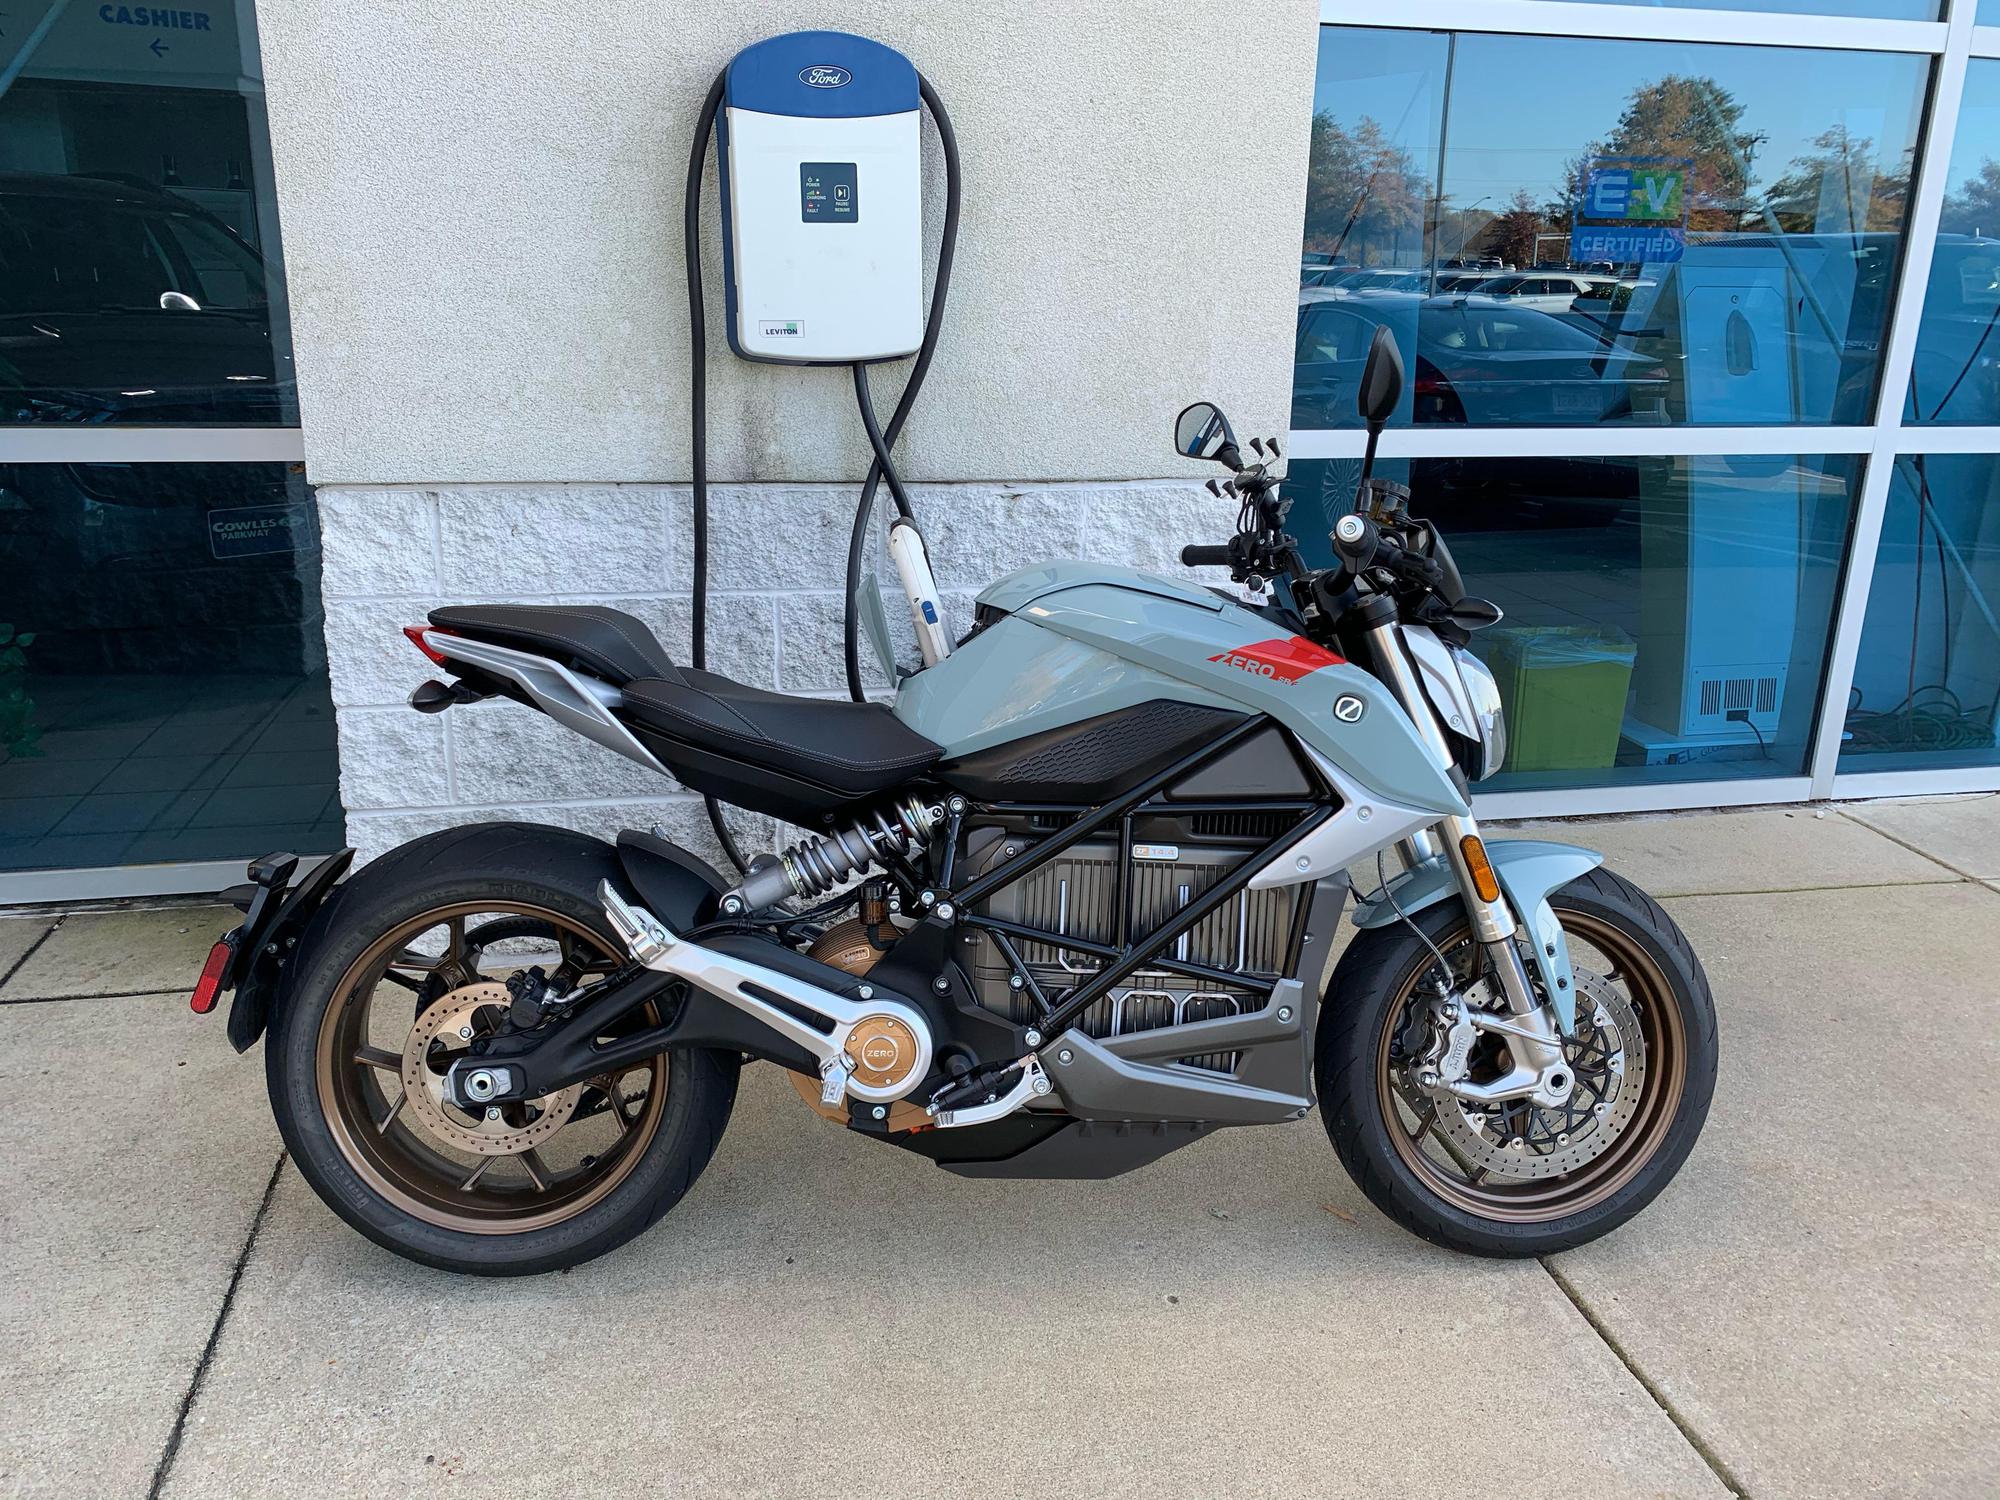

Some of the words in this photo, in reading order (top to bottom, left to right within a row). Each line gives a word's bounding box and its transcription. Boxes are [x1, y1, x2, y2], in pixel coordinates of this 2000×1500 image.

[99, 4, 211, 31] CASHIER
[809, 68, 841, 84] Ford
[1580, 236, 1676, 253] CERTIFIED
[212, 518, 277, 533] COWLES
[221, 528, 270, 541] PARKWAY
[1214, 653, 1276, 679] ZERO
[866, 1050, 895, 1058] ZERO
